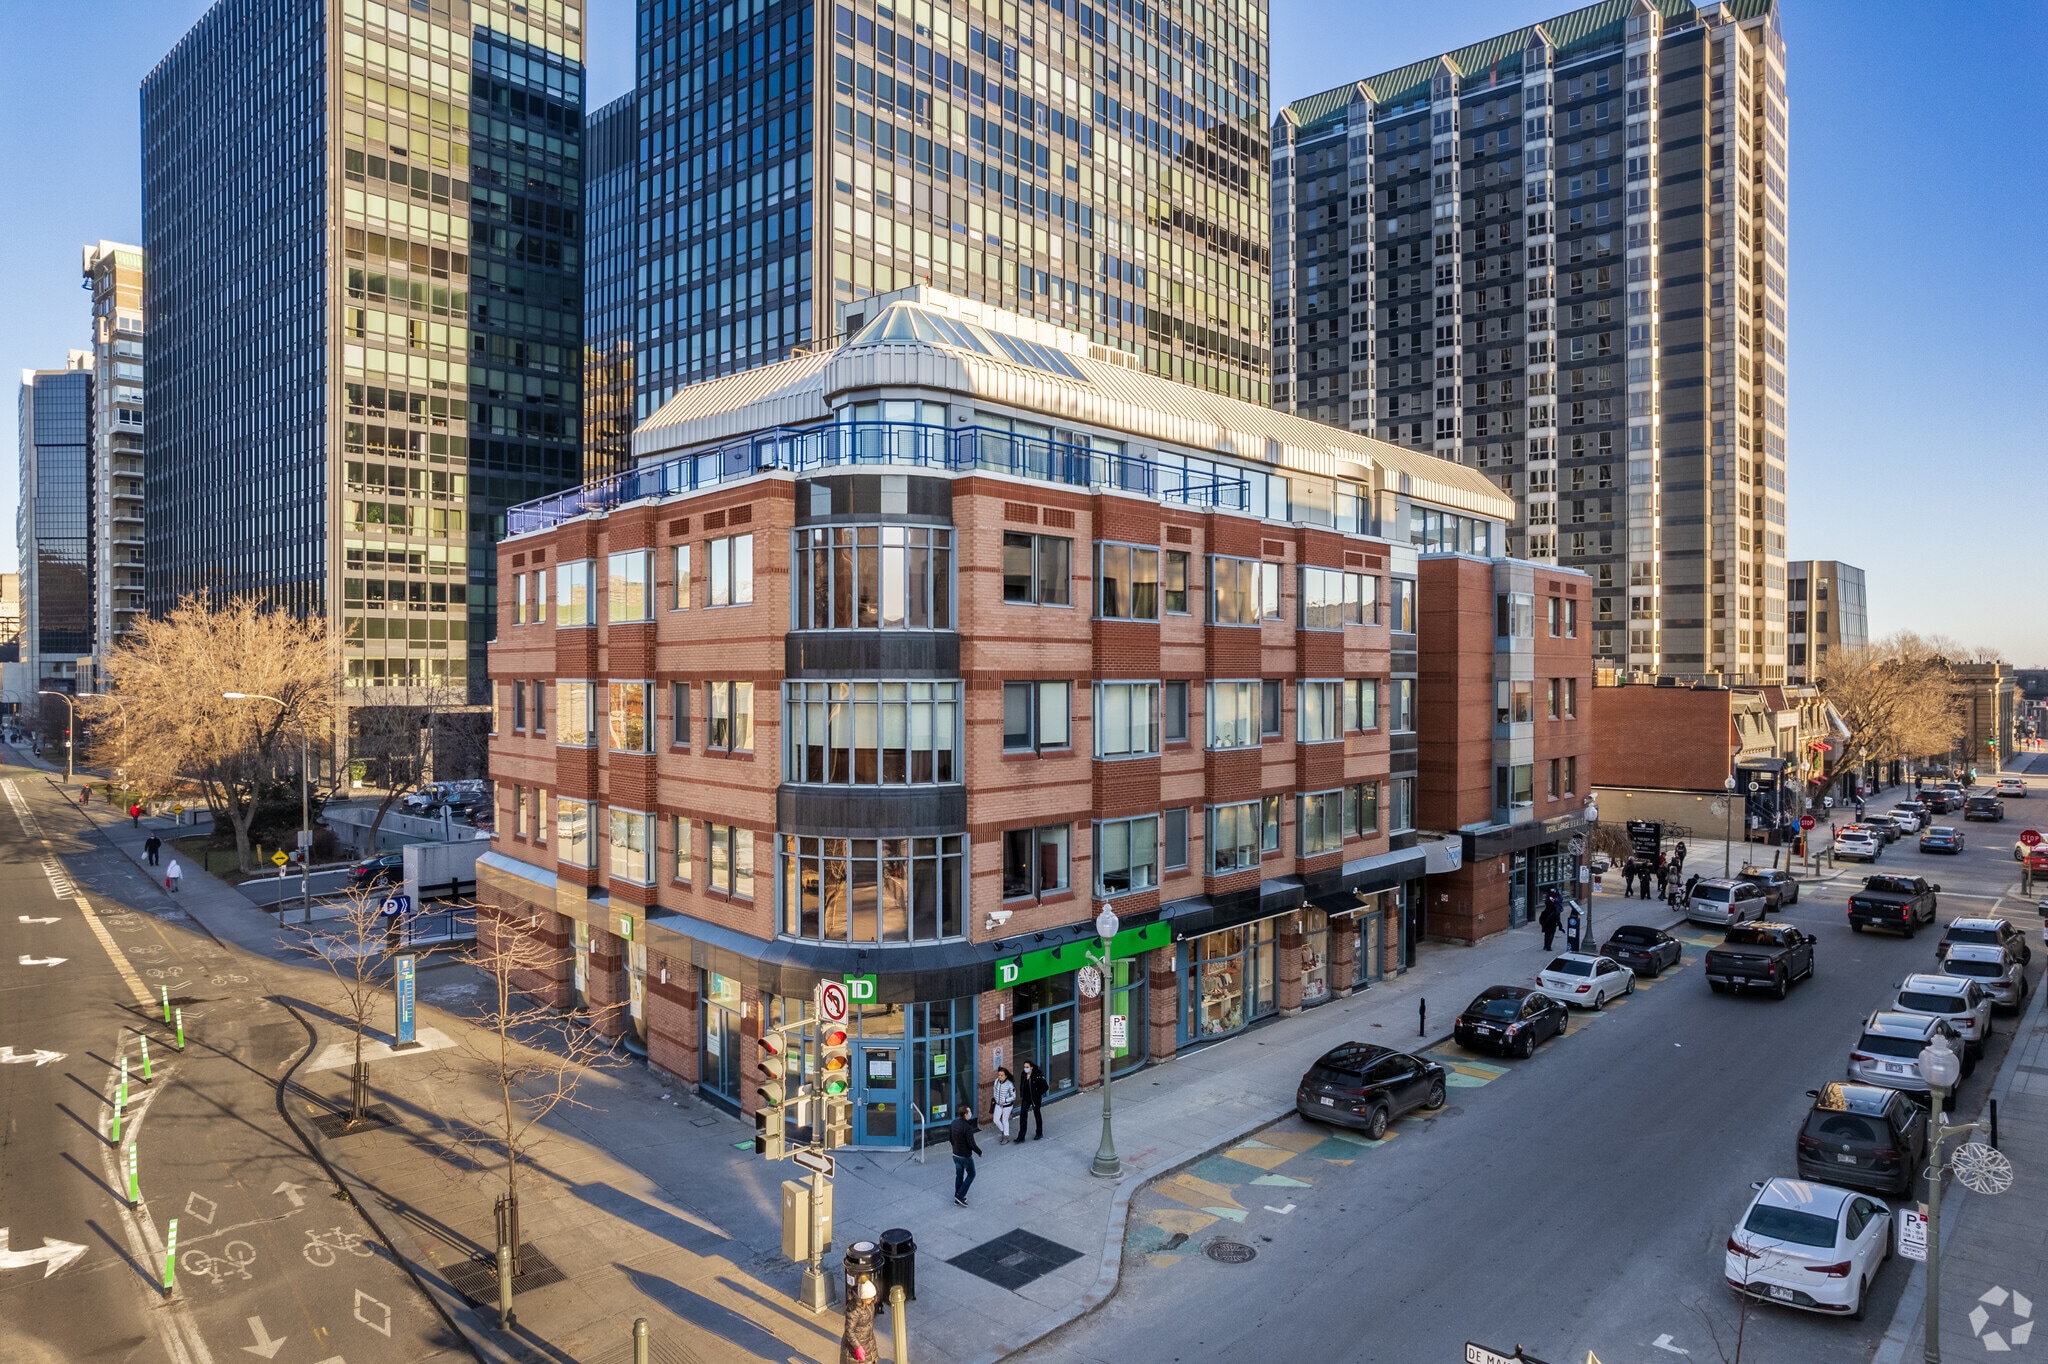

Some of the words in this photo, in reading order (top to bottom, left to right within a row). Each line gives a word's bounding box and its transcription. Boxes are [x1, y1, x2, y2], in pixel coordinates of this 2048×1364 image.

[620, 918, 631, 936] TD
[1000, 963, 1018, 984] TD
[846, 979, 874, 999] TD
[1469, 1348, 1481, 1362] DE
